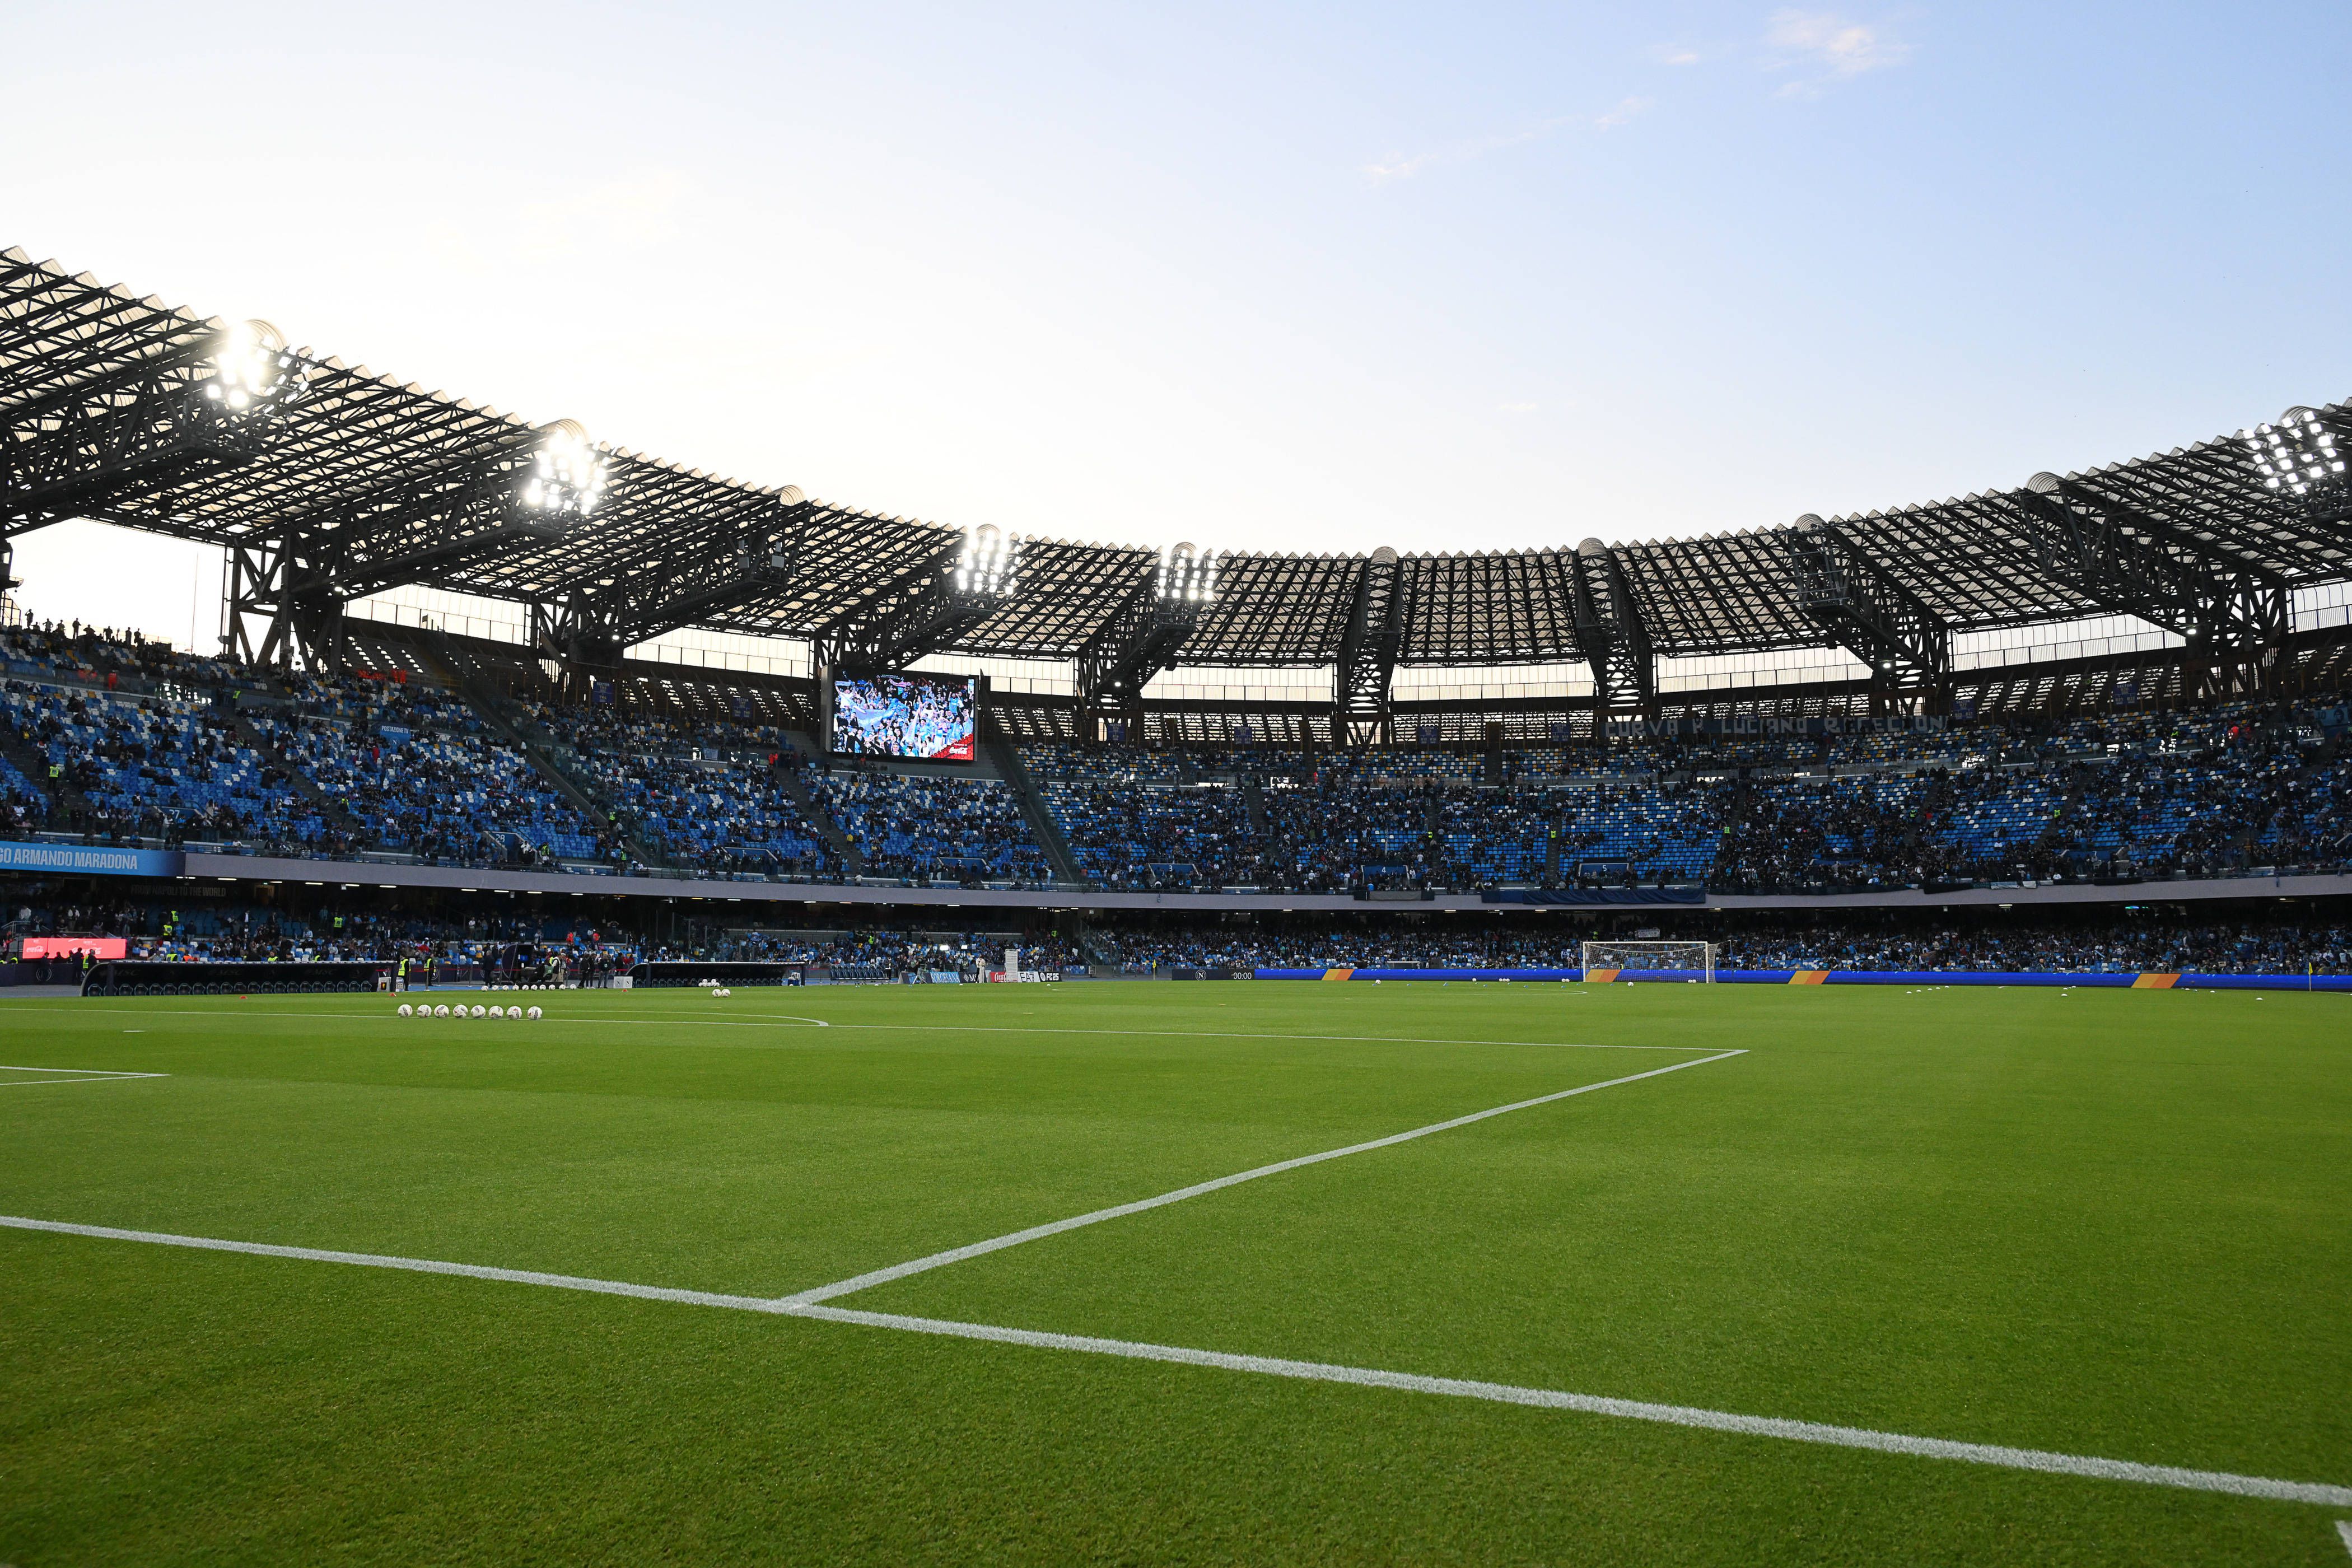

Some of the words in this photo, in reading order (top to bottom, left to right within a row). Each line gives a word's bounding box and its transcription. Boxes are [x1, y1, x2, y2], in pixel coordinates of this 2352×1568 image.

[1605, 719, 1678, 738] CURVA
[169, 809, 180, 819] 27
[496, 833, 505, 843] 28
[13, 848, 73, 866] ARMANDO
[74, 852, 138, 870] MARADONA
[179, 886, 189, 896] TO
[189, 886, 202, 896] THE
[202, 887, 226, 897] WORLD
